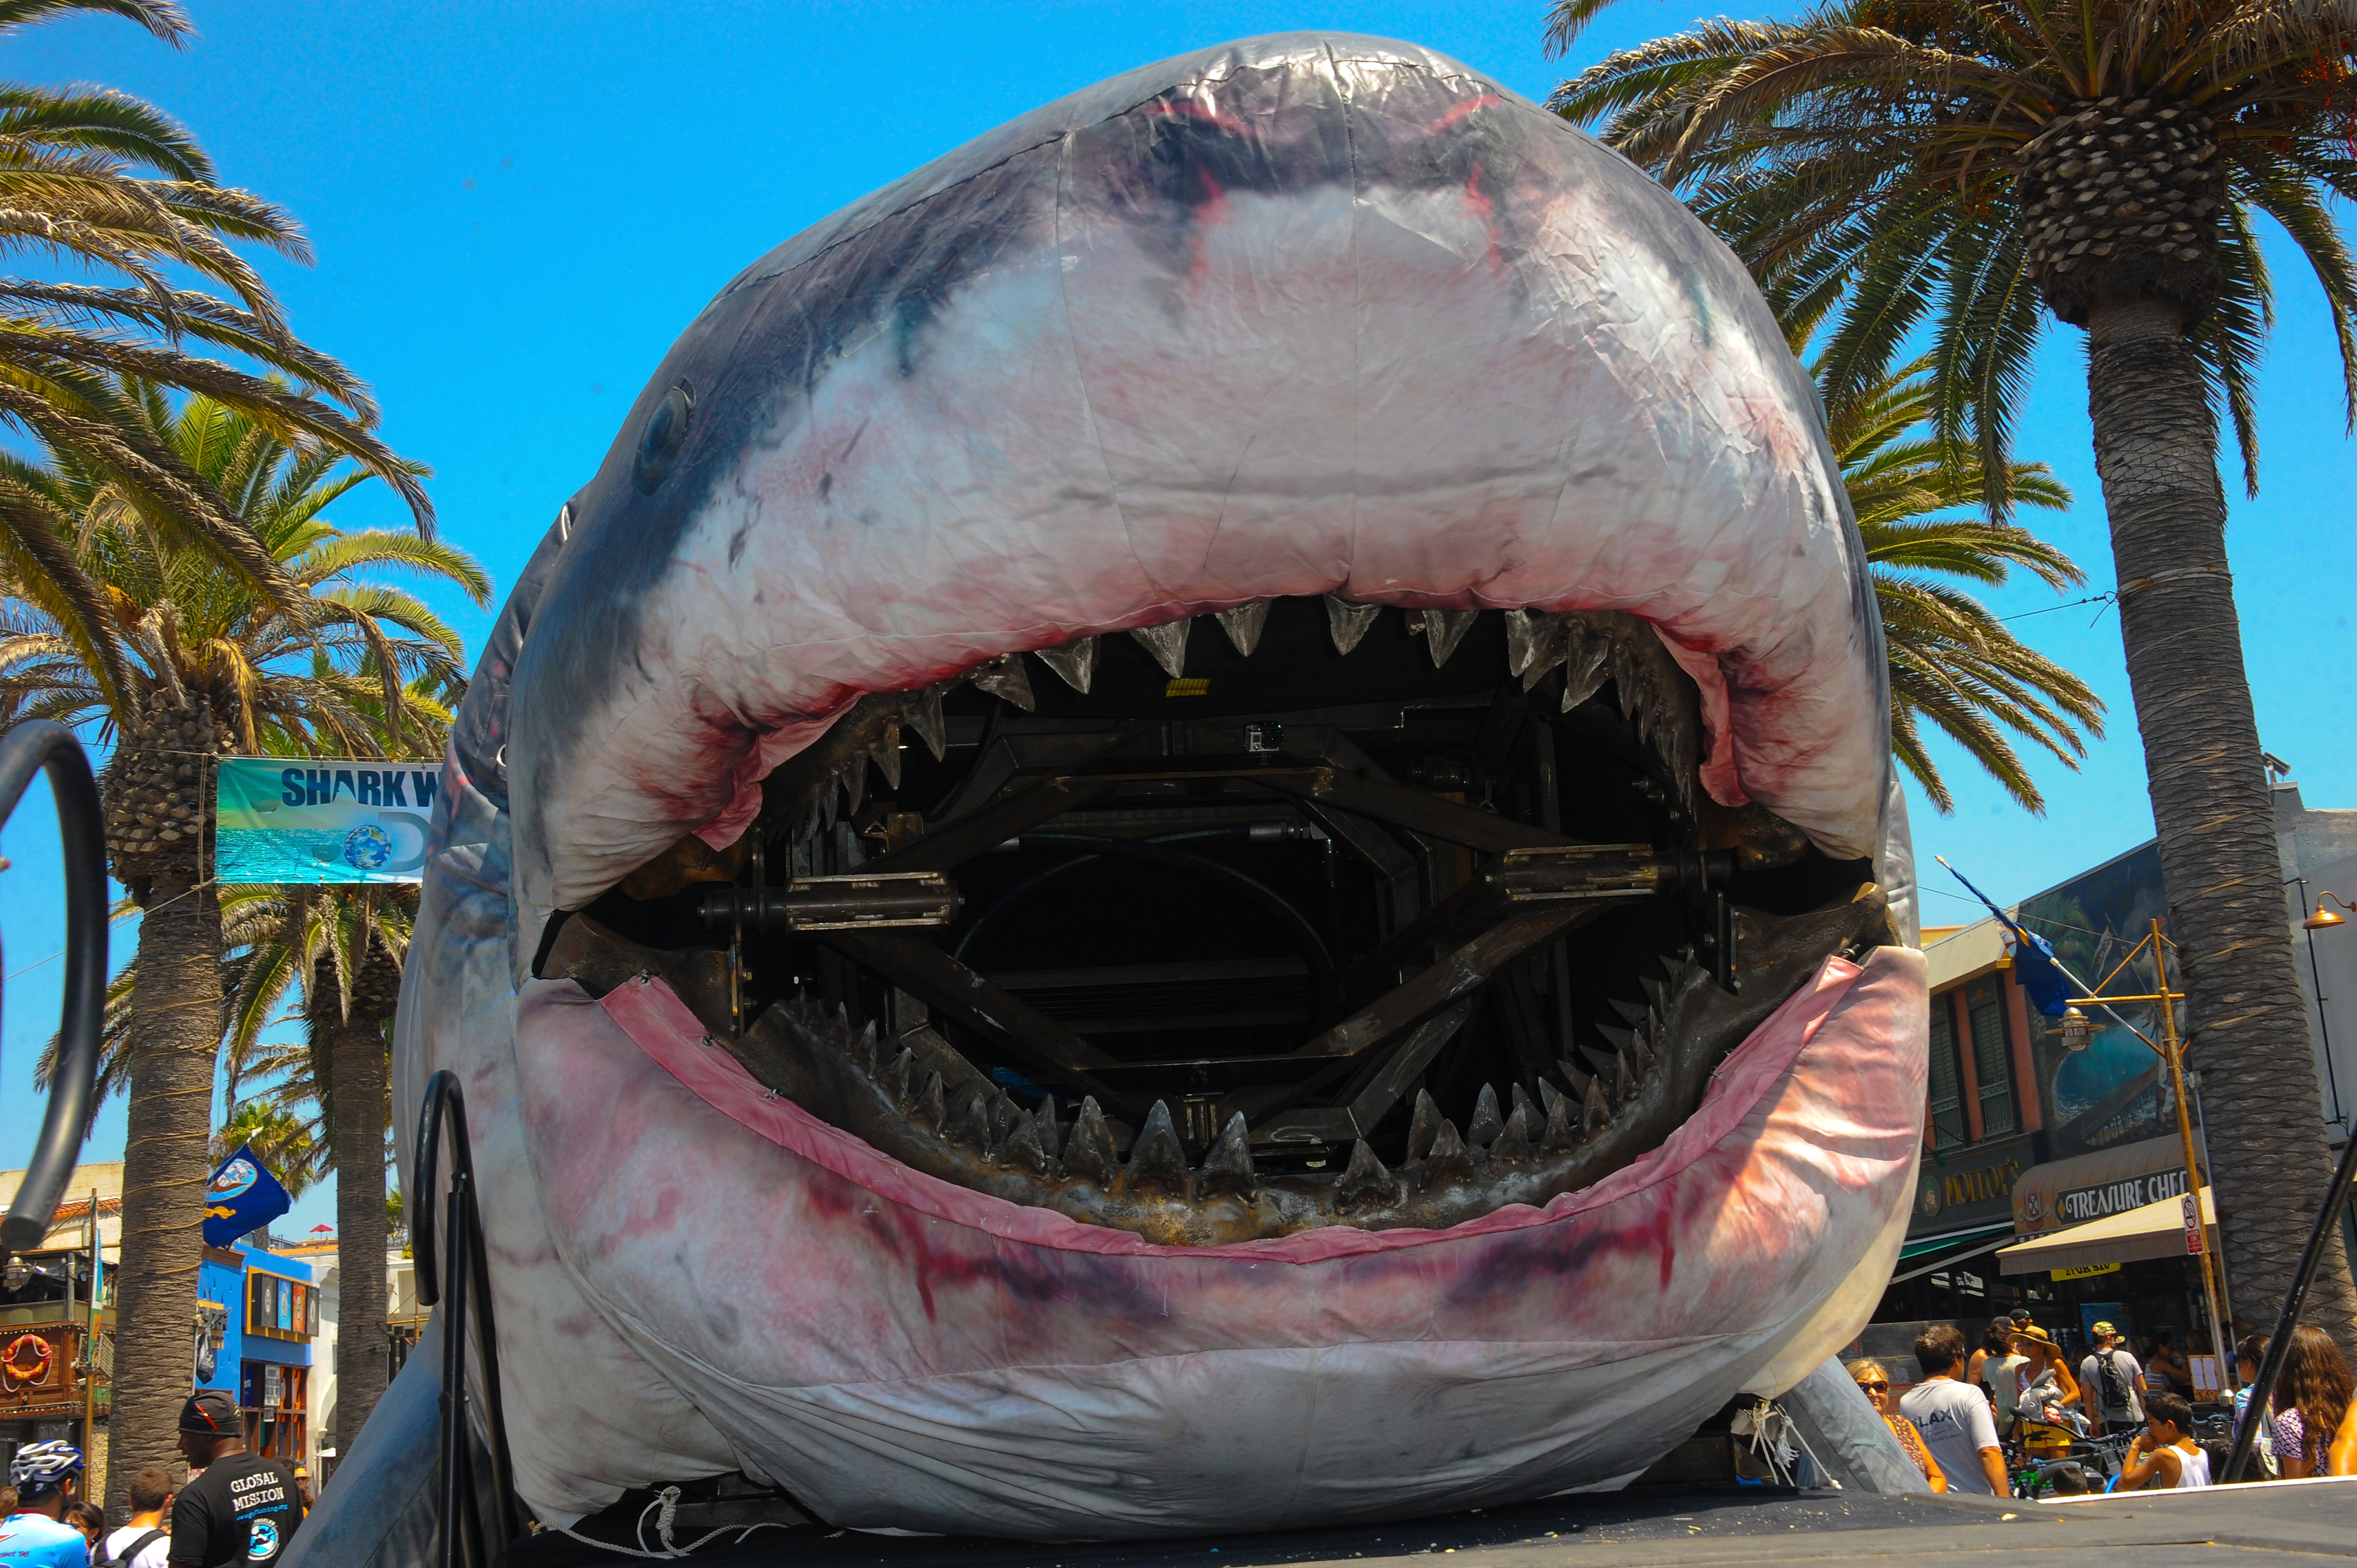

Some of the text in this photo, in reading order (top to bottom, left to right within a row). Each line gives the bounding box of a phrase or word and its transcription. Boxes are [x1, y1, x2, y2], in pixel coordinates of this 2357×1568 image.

[281, 768, 408, 807] SHARK
[2065, 1170, 2187, 1219] TREASURE CHES
[230, 1471, 279, 1493] GLOBAL
[232, 1486, 284, 1512] MISSION
